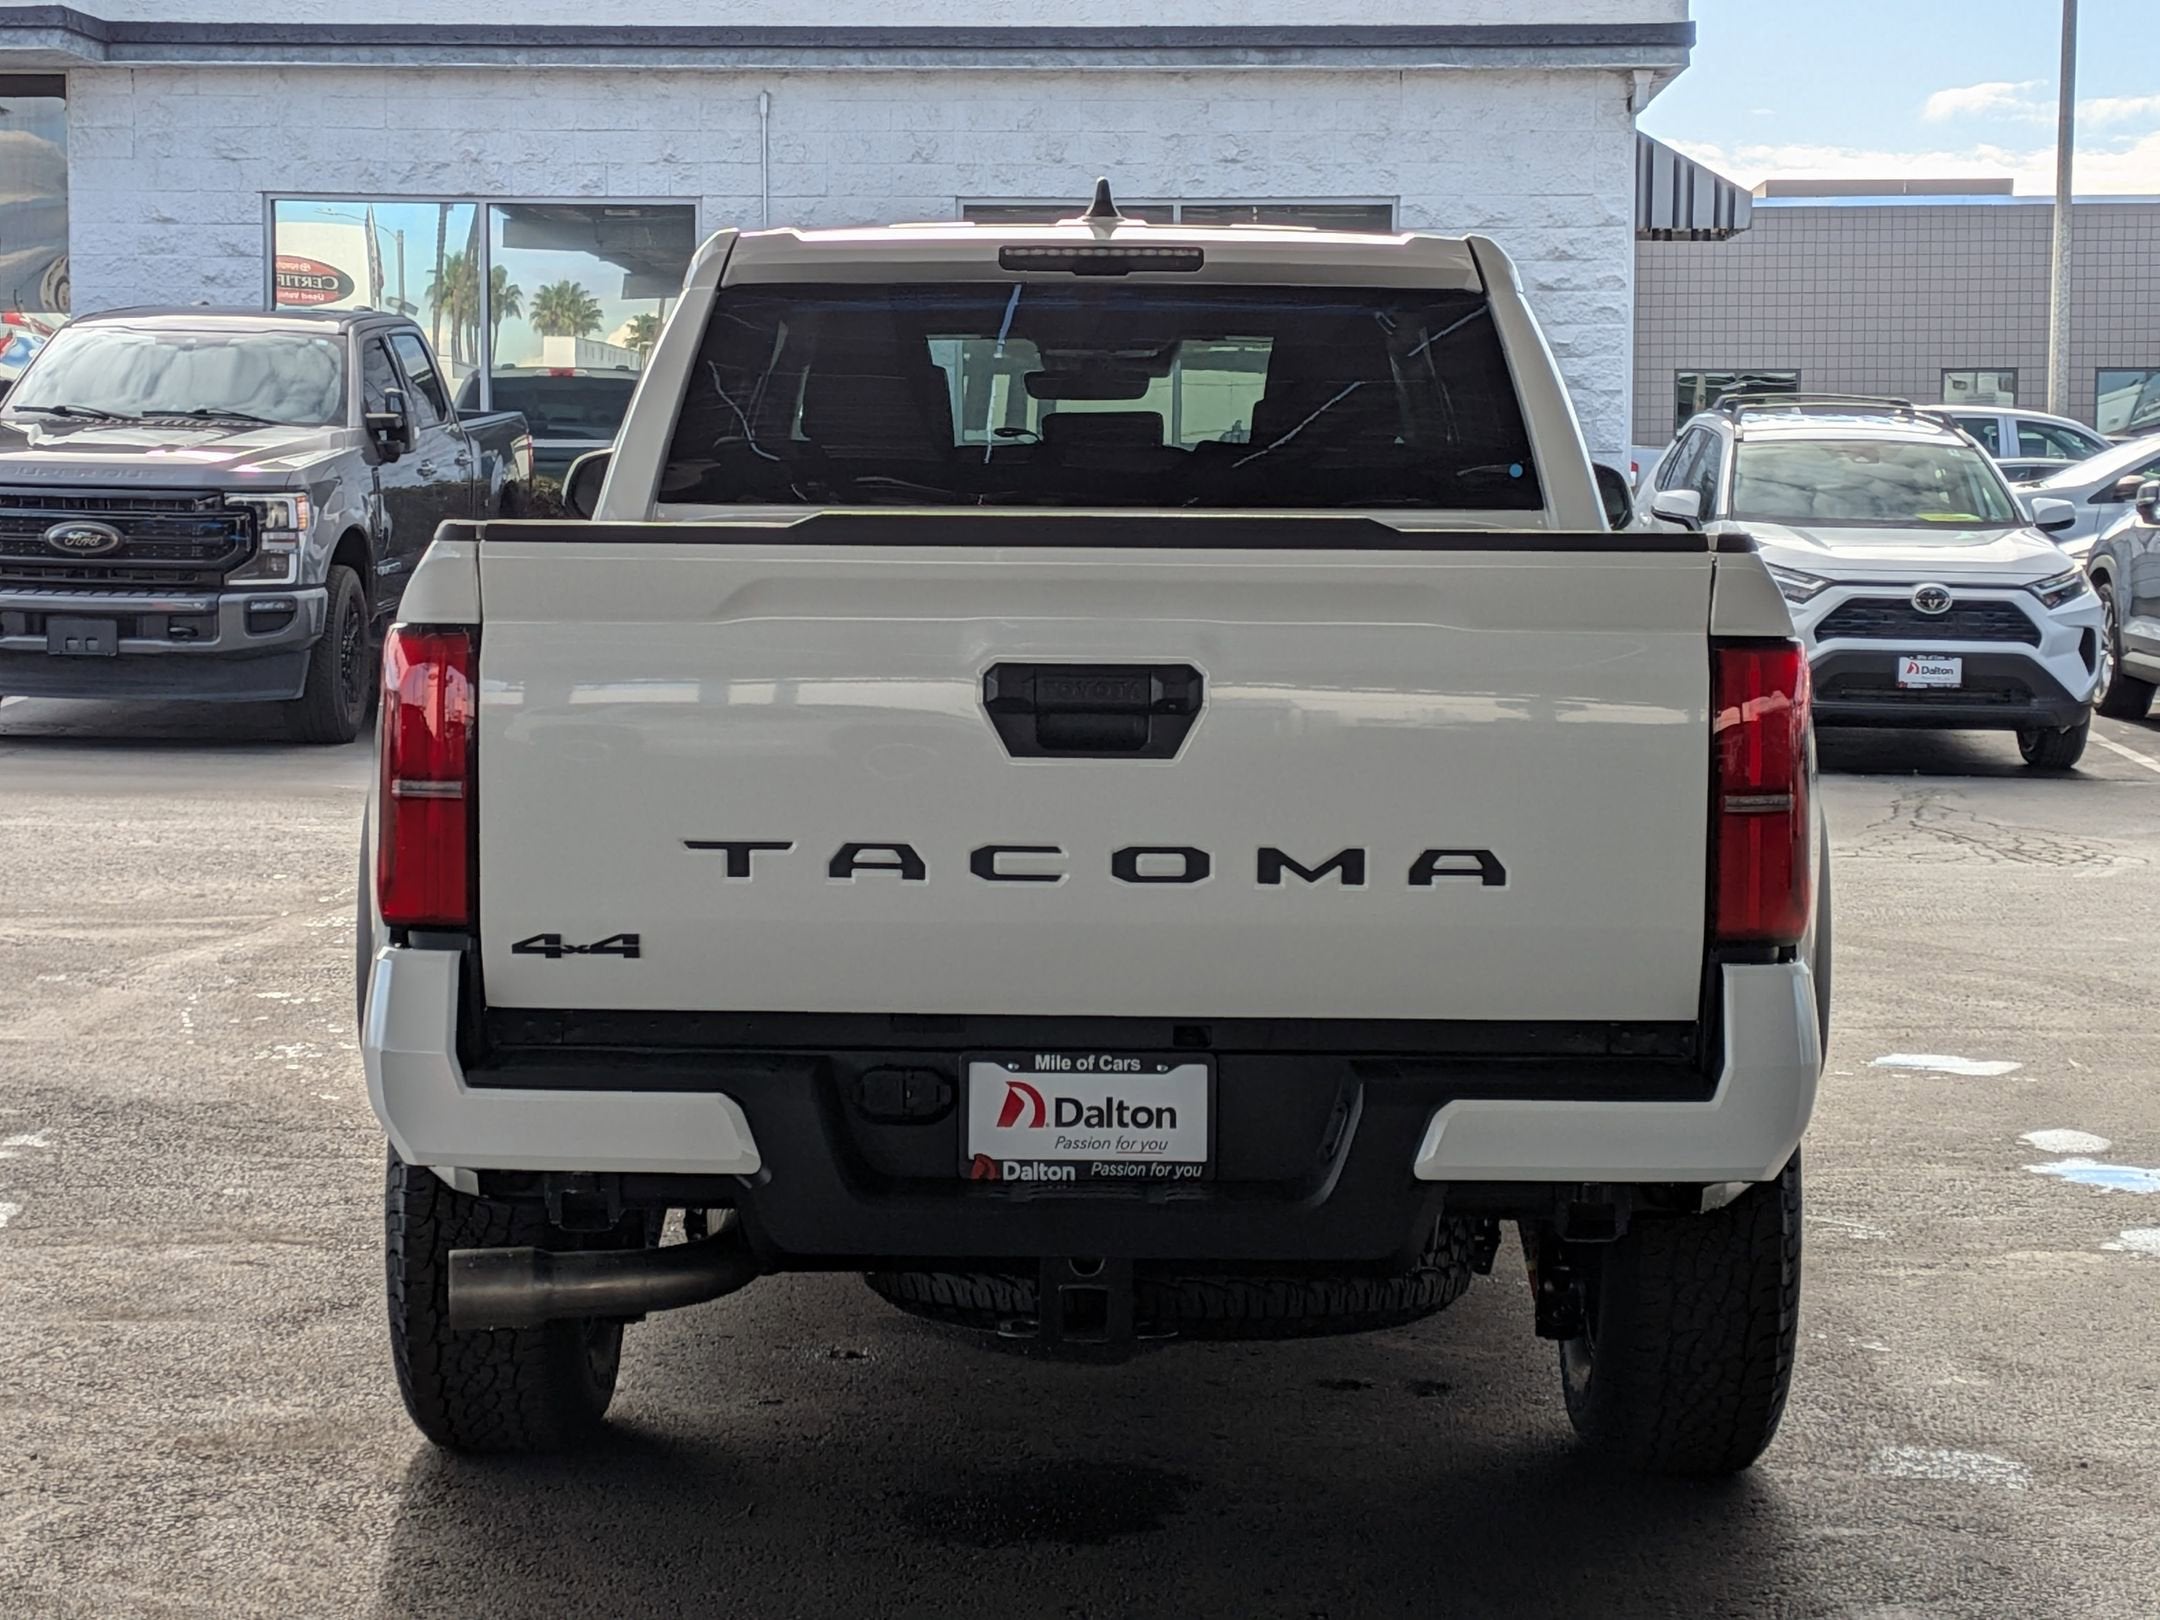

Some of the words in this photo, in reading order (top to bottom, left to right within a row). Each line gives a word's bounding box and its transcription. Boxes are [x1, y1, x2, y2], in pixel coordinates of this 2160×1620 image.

[65, 531, 102, 546] Ford
[1921, 666, 1954, 675] Dalton
[683, 841, 1507, 887] TACOMA
[1035, 1055, 1071, 1071] Mile
[1076, 1055, 1095, 1071] of
[1099, 1055, 1141, 1072] Cars
[1055, 1097, 1177, 1129] Dalton
[1055, 1136, 1110, 1150] Passion
[1115, 1136, 1136, 1151] for
[1140, 1139, 1168, 1153] you
[1003, 1161, 1076, 1181] Dalton
[1091, 1162, 1146, 1177] Passion
[1150, 1162, 1173, 1177] for
[1175, 1164, 1203, 1179] you
